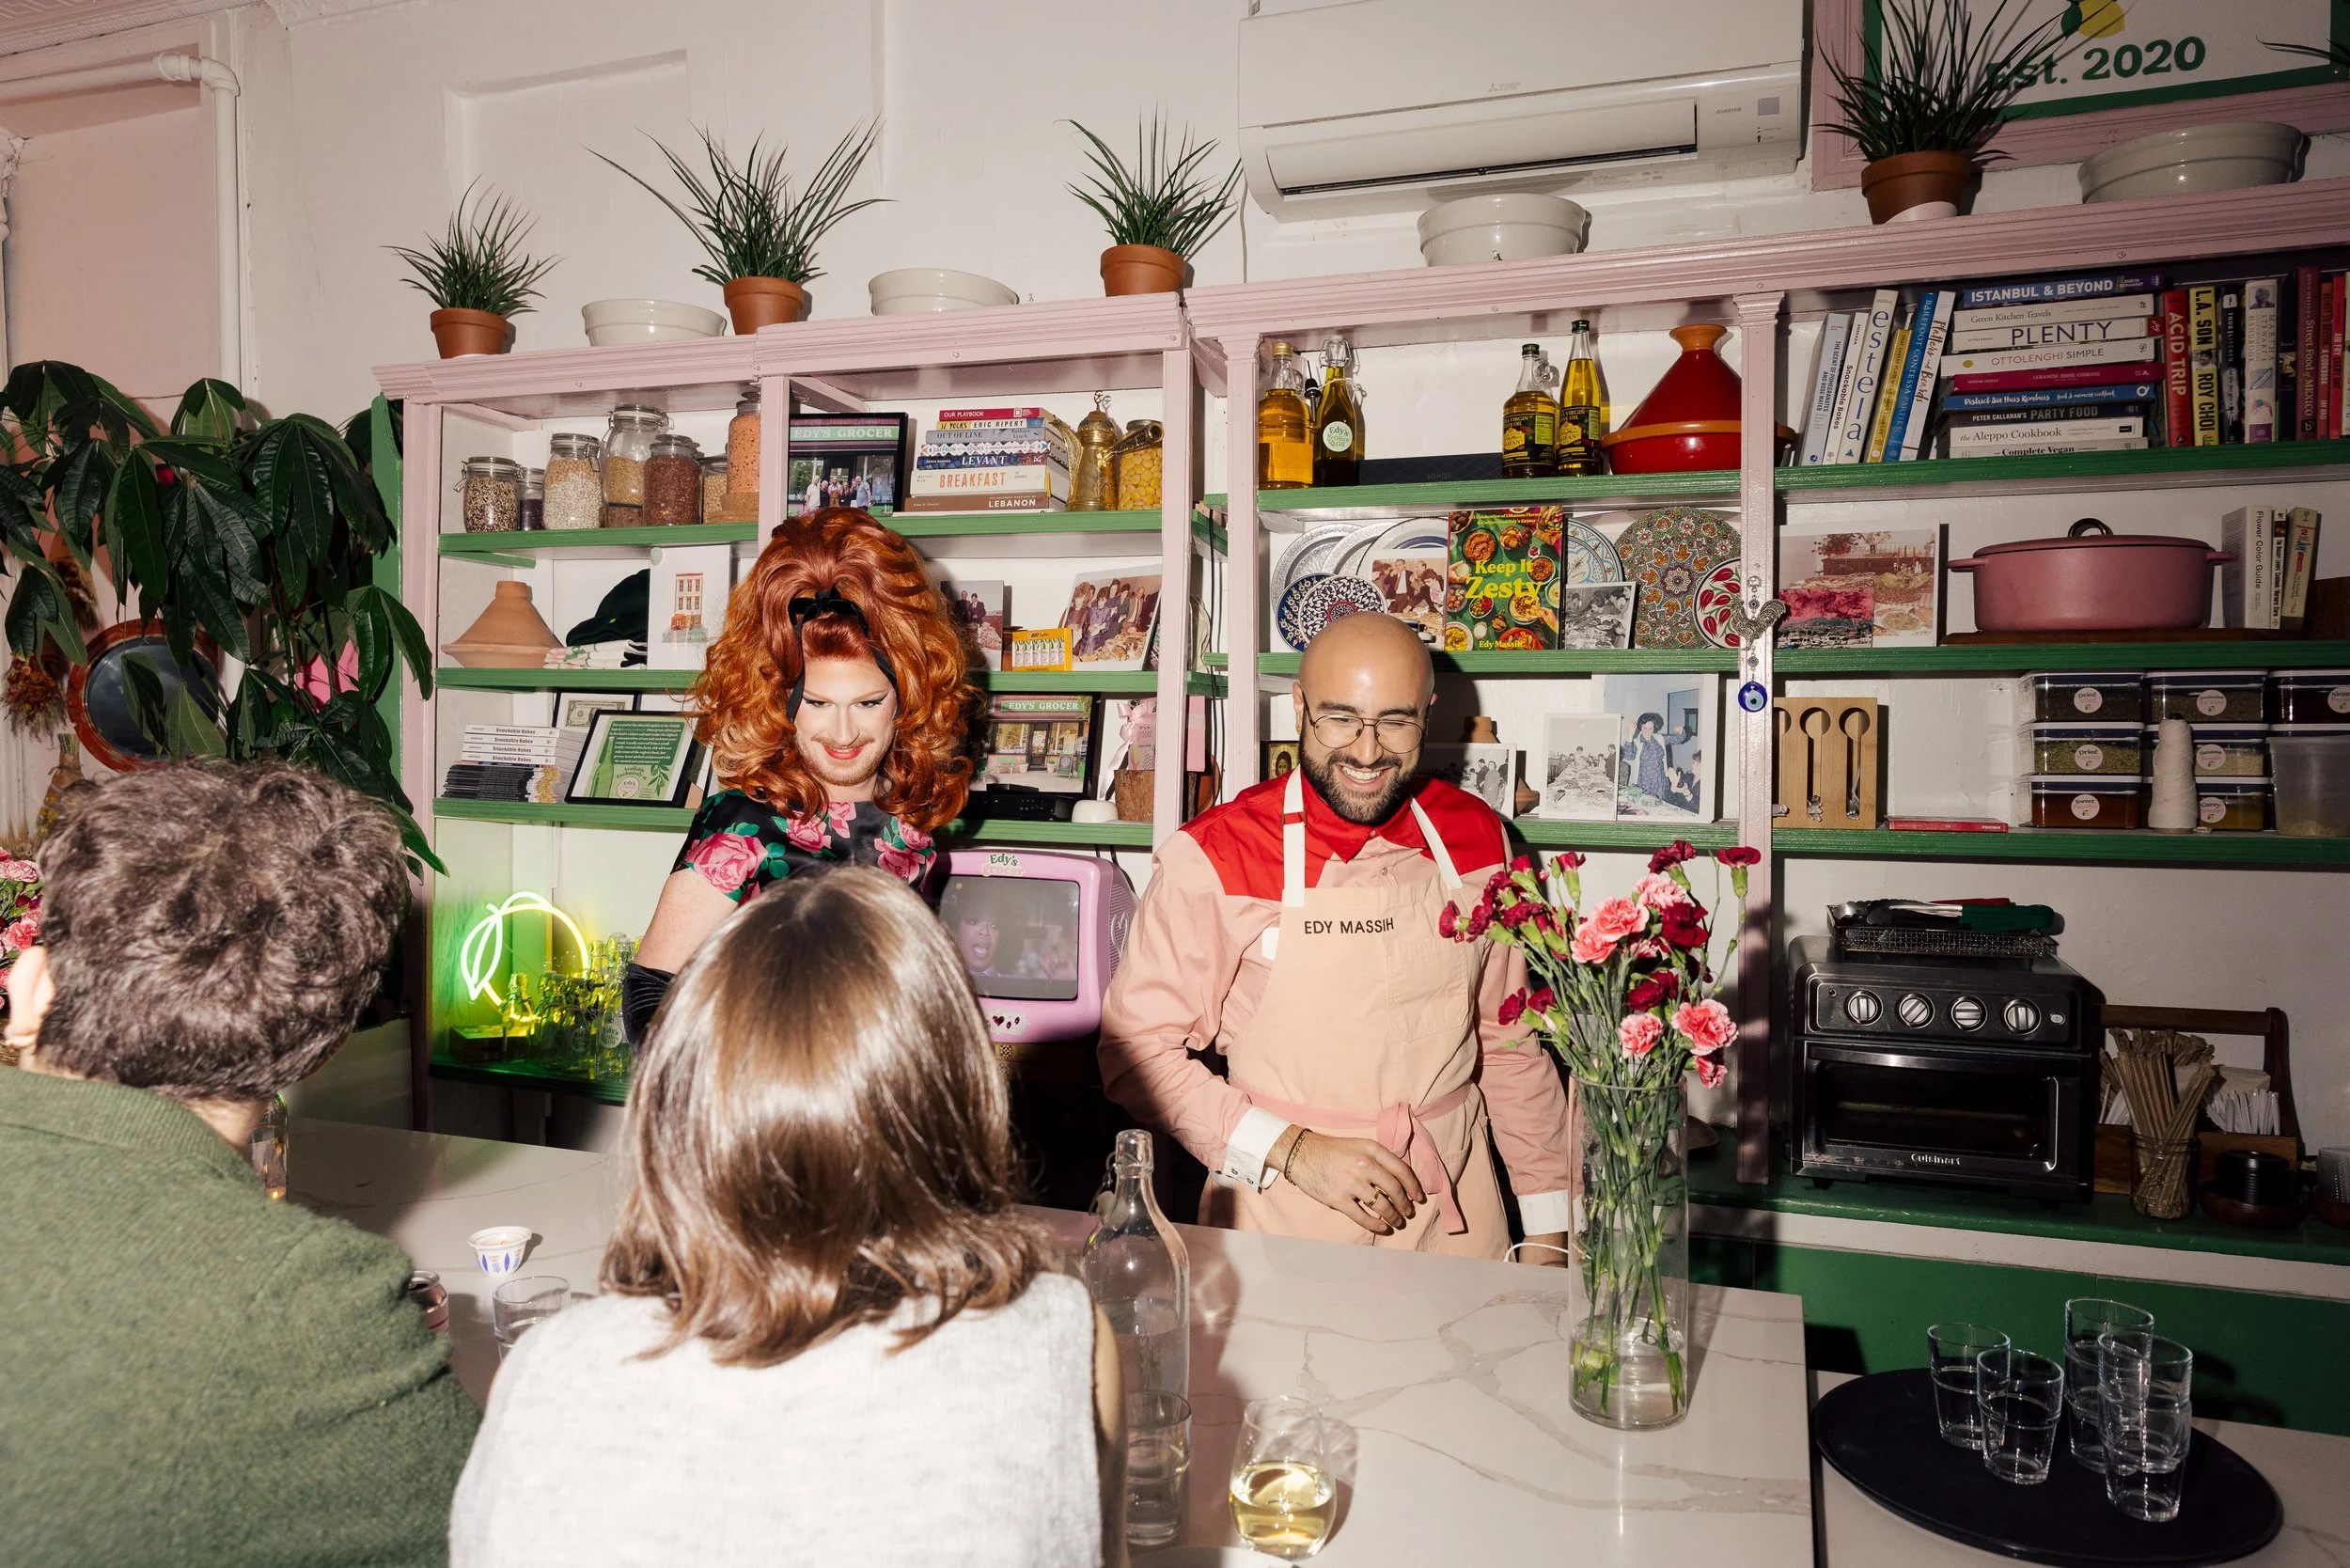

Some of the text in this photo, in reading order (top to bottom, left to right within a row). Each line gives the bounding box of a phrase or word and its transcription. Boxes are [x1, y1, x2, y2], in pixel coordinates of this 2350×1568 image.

[2082, 36, 2206, 80] 2020
[1971, 279, 2114, 303] ISTANBUL & BEYOND
[1915, 298, 1932, 347] BAREFOOT
[1970, 308, 2052, 324] Green Kitchen Travels
[2195, 290, 2213, 346] L.A. SON
[2012, 321, 2113, 346] PLENTY
[2305, 319, 2314, 347] Street
[2333, 332, 2342, 343] AIR
[1991, 348, 2104, 366] OTTOLENGHI SIMPLE
[2169, 312, 2187, 396] ACID TRIP
[2333, 344, 2341, 355] FRY
[1915, 320, 1947, 404] Platters Boards
[2305, 349, 2313, 370] Food
[2332, 356, 2341, 374] EVERY
[1847, 310, 1889, 441] estela
[1903, 348, 1921, 394] CONTESSA
[2332, 377, 2340, 388] DAY
[1823, 373, 1835, 412] POMEGRANATES
[1833, 365, 1853, 429] Snackable Bakes
[1964, 396, 1990, 407] District
[1990, 395, 2003, 405] Six
[2003, 395, 2021, 404] Huis
[2304, 378, 2313, 416] MEXICO
[2198, 373, 2215, 431] ROY CHOI
[1972, 405, 2099, 422] PETER CALLAHAN'S PARTY FOOD
[794, 428, 893, 439] EDY'S GROCER
[1329, 426, 1349, 437] Edy's
[1973, 431, 2009, 443] Aleppo
[2011, 427, 2062, 440] Cookbook
[962, 455, 1007, 466] LEVANT
[2002, 446, 2075, 457] Complete Vegan
[940, 471, 1006, 488] BREAKFAST
[988, 499, 1036, 508] LEBANON
[1475, 558, 1533, 577] Keep It
[1465, 576, 1543, 604] Zesty
[990, 853, 1018, 866] Edy's
[983, 865, 1024, 876] grocer
[1304, 917, 1394, 934] EDY MASSIH
[1911, 1153, 1960, 1165] Cuisinart
